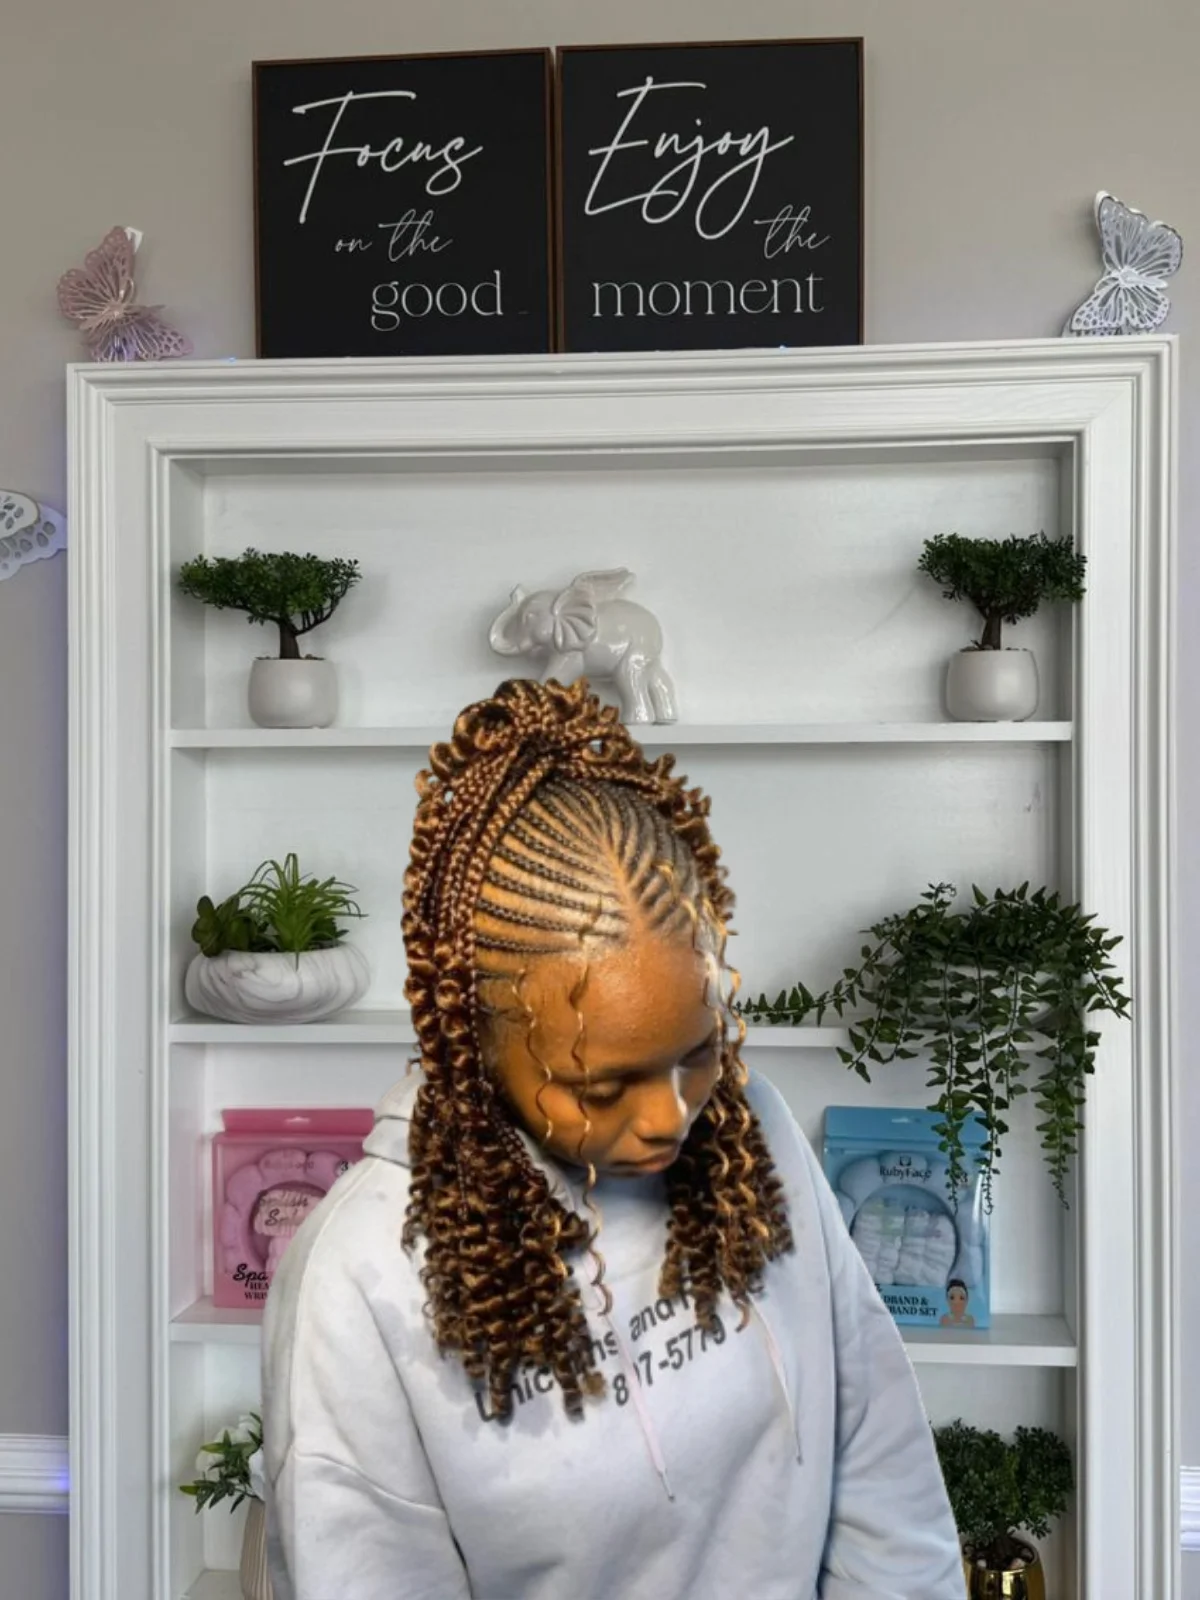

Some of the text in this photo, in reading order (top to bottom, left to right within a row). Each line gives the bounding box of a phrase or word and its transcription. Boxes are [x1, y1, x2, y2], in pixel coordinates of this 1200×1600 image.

[283, 90, 484, 224] Focus
[584, 76, 795, 240] Enjoy
[334, 208, 454, 262] on the
[753, 204, 831, 260] the
[370, 269, 504, 332] good
[591, 271, 825, 317] moment
[232, 1262, 269, 1288] Spa
[919, 1308, 939, 1317] SET
